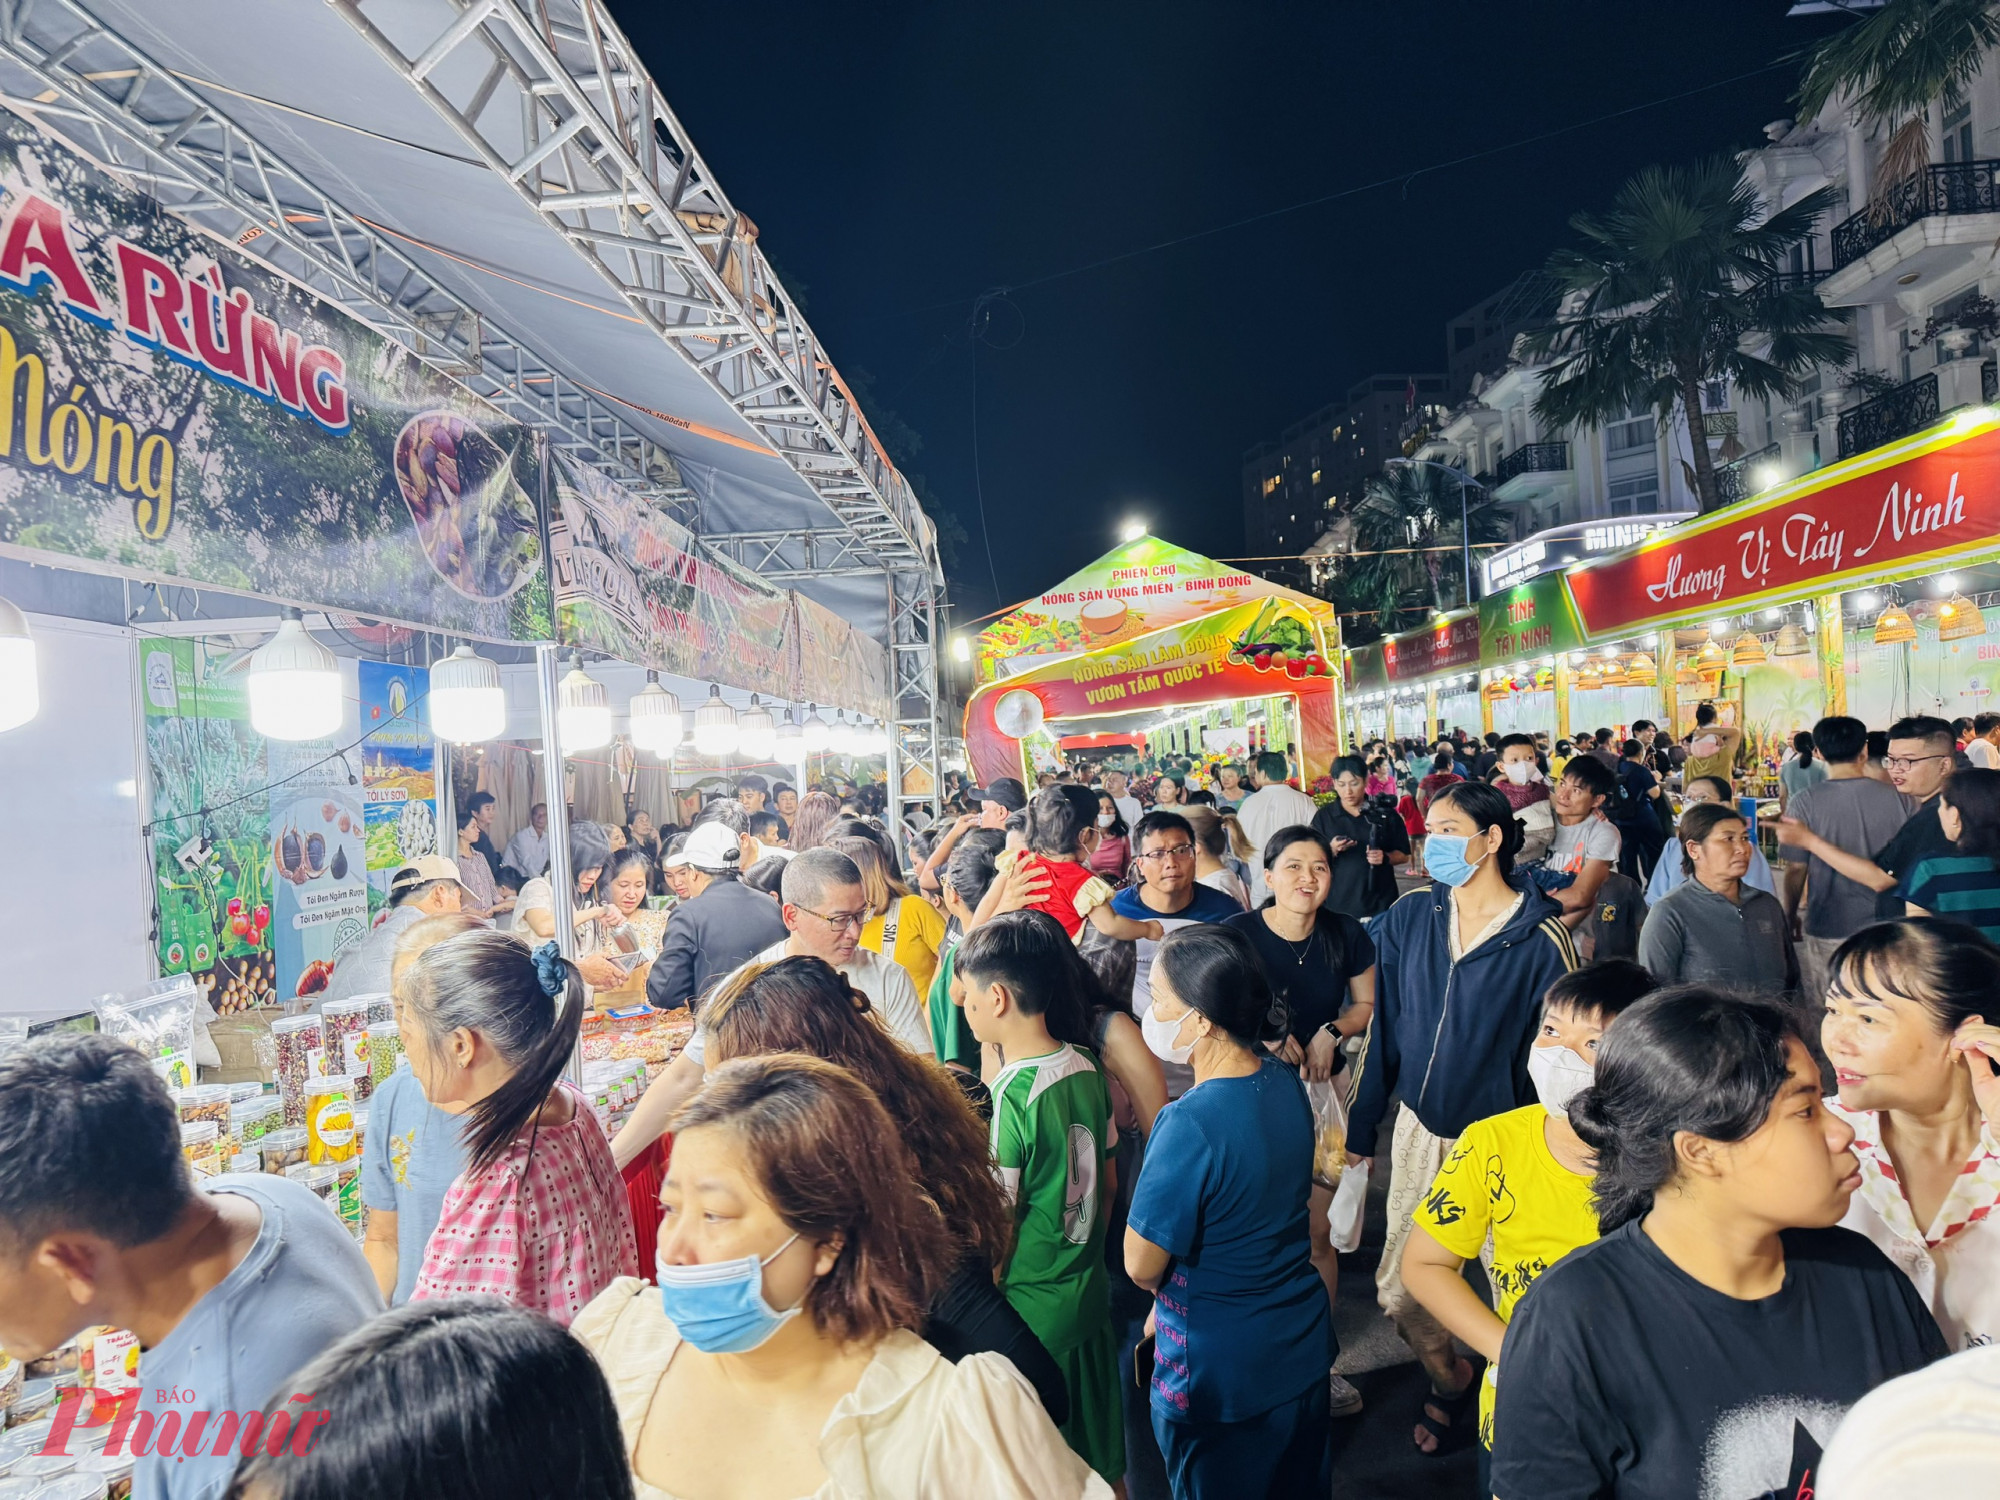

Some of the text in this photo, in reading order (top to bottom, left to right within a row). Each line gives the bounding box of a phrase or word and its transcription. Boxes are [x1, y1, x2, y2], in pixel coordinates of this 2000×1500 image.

[114, 239, 349, 429] RỪNG
[1646, 471, 1966, 602] Hương Vị Tây Ninh
[1152, 563, 1176, 578] CHỢ
[1041, 592, 1075, 606] NÔNG
[1079, 586, 1104, 602] SẢN
[1186, 578, 1215, 592] BÌNH
[1507, 595, 1536, 626] TỈNH
[1495, 623, 1552, 658] TÂY NINH
[1072, 633, 1228, 685] NÔNG SẢN LÂM ĐỒNG
[1085, 683, 1127, 706] VƯƠN
[1163, 660, 1204, 687] QUỐC
[1205, 653, 1225, 675] TẾ
[306, 888, 365, 905] Tỏi Đen Ngâm Rượu
[300, 914, 311, 925] Tỏi
[311, 912, 323, 922] Đen
[324, 909, 341, 921] Ngâm
[341, 906, 354, 917] Mật
[1063, 1123, 1098, 1244] 9
